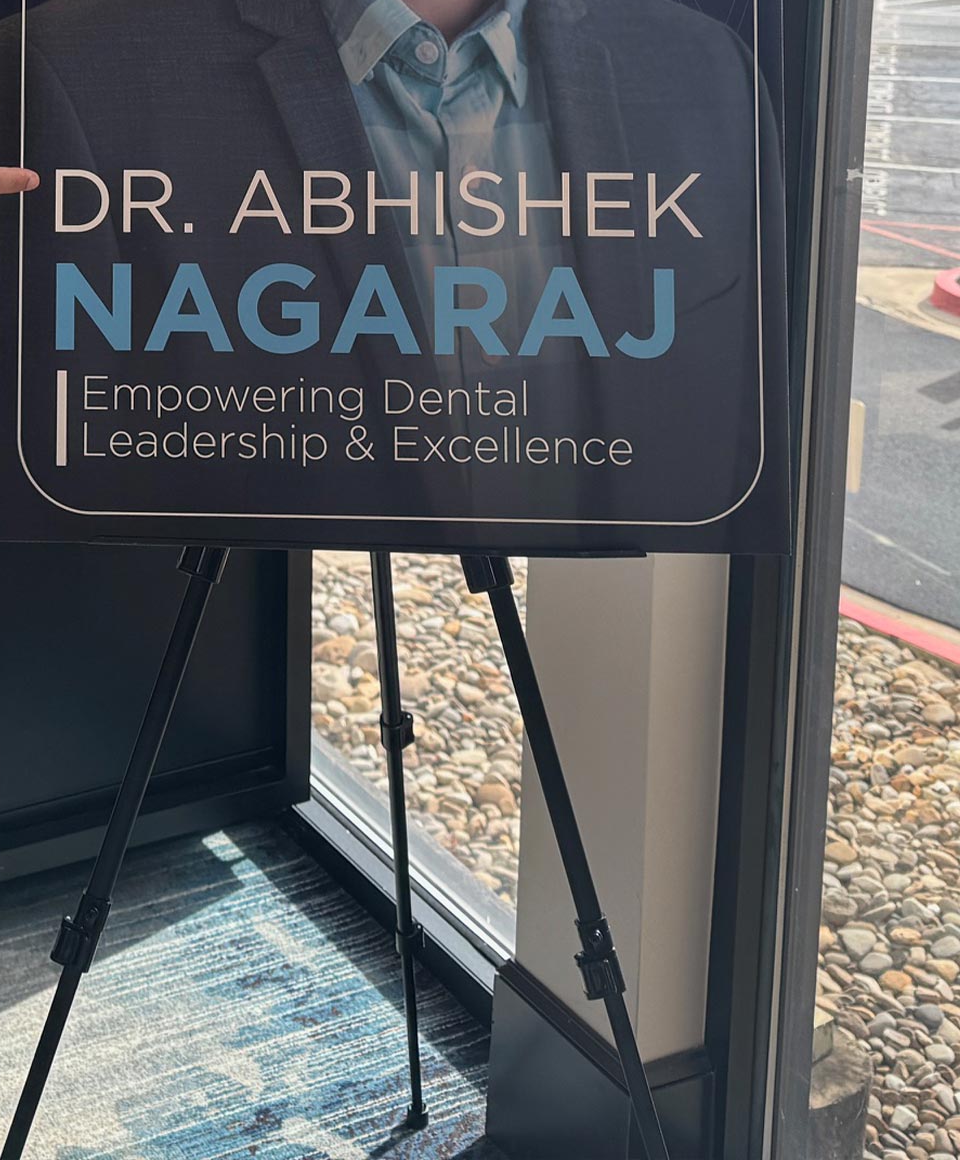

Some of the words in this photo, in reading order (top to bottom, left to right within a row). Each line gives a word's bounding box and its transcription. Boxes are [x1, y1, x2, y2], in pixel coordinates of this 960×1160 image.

[54, 168, 194, 234] DR.
[228, 169, 704, 239] ABHISHEK
[55, 262, 676, 359] NAGARAJ
[83, 375, 364, 421] Empowering
[384, 379, 528, 417] Dental
[83, 421, 328, 467] Leadership
[345, 425, 375, 461] &
[394, 426, 634, 466] Excellence
